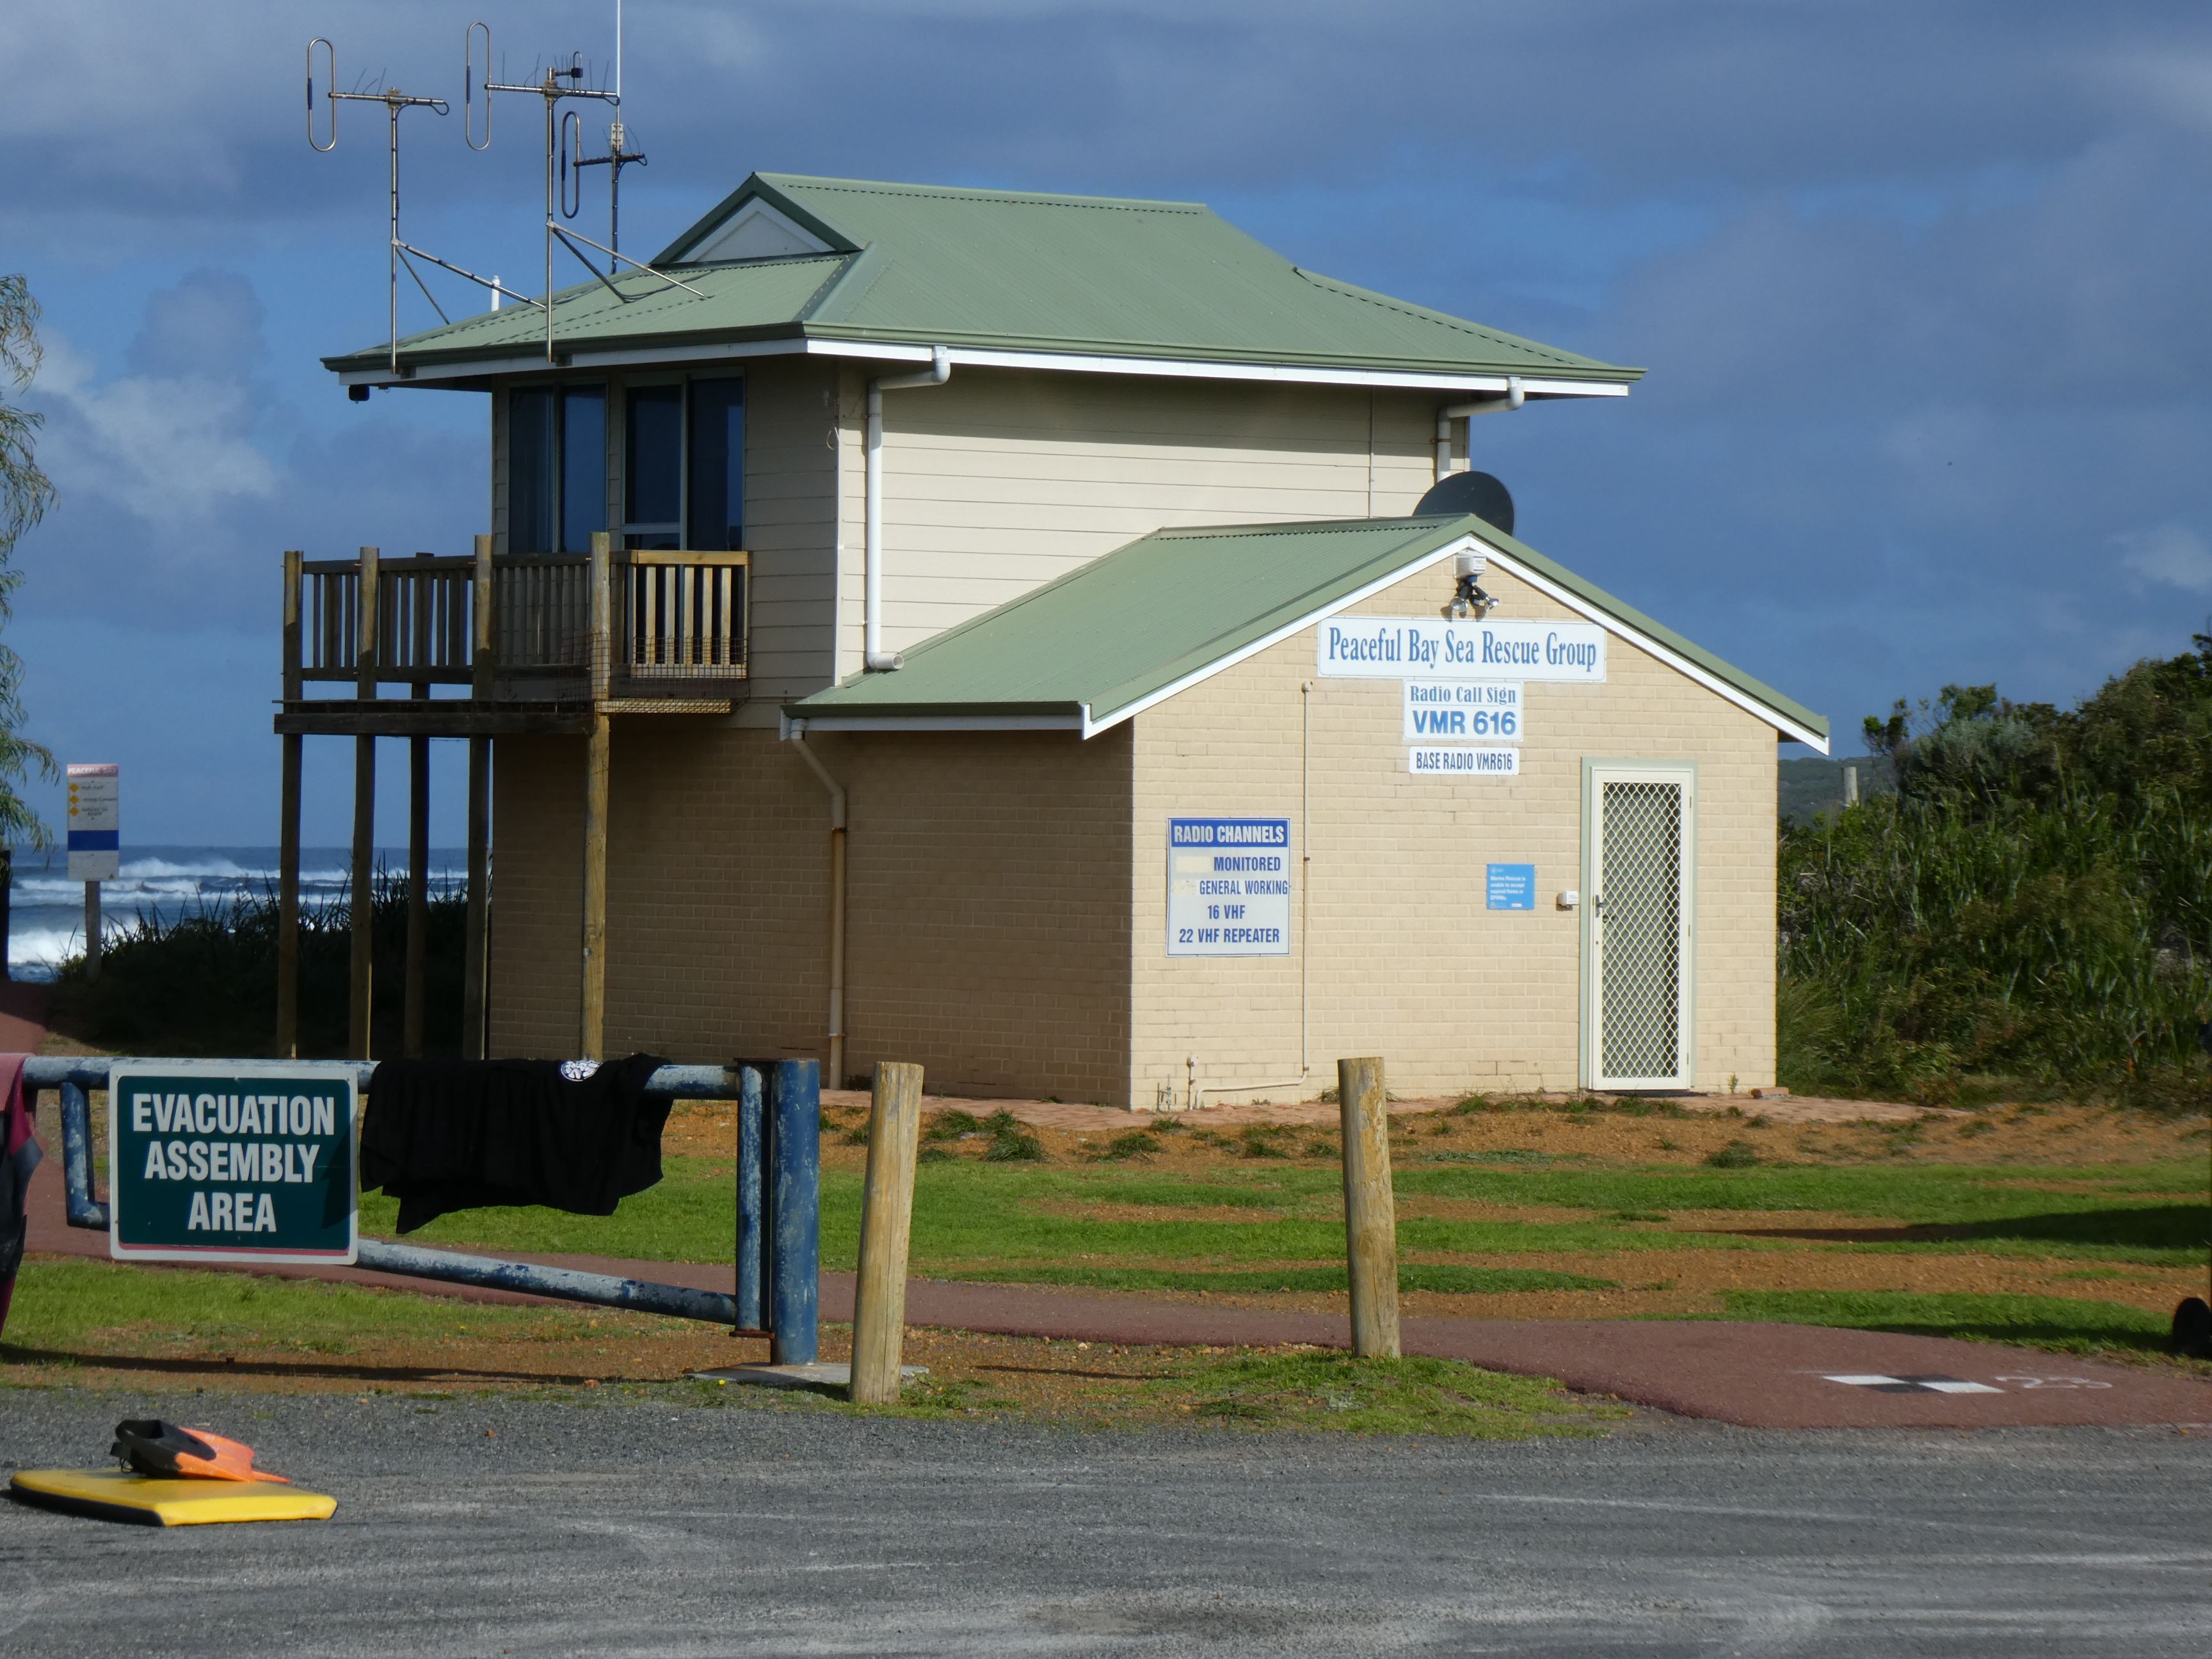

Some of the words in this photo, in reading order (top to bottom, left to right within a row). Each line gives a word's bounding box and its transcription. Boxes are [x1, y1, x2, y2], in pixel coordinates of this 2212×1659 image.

[1329, 627, 1402, 662] Peaceful
[1408, 629, 1439, 669] Bay
[1445, 629, 1475, 663] Sea
[1482, 630, 1539, 664] Rescue
[1546, 632, 1596, 673] Group
[1410, 685, 1451, 702] Radio
[1456, 686, 1482, 703] Call
[1487, 687, 1516, 705] Sign
[1413, 710, 1465, 734] VMR
[1473, 710, 1516, 735] 616
[1416, 752, 1440, 769] BASE
[1443, 752, 1473, 770] RADIO
[1476, 753, 1512, 771] VMR616
[1174, 825, 1214, 843] RADIO
[1217, 826, 1285, 843] CHANNELS
[1214, 856, 1281, 872] MONITORED
[1199, 880, 1241, 895] GENERAL
[1244, 880, 1288, 895] WORKING
[1208, 904, 1220, 920] 16
[1224, 904, 1246, 919] VHF
[1179, 928, 1194, 943] 22
[1198, 928, 1220, 943] VHF
[1223, 928, 1279, 943] REPEATER
[132, 1093, 335, 1136] EVACUATION
[144, 1140, 320, 1183] ASSEMBLY
[188, 1192, 277, 1233] AREA
